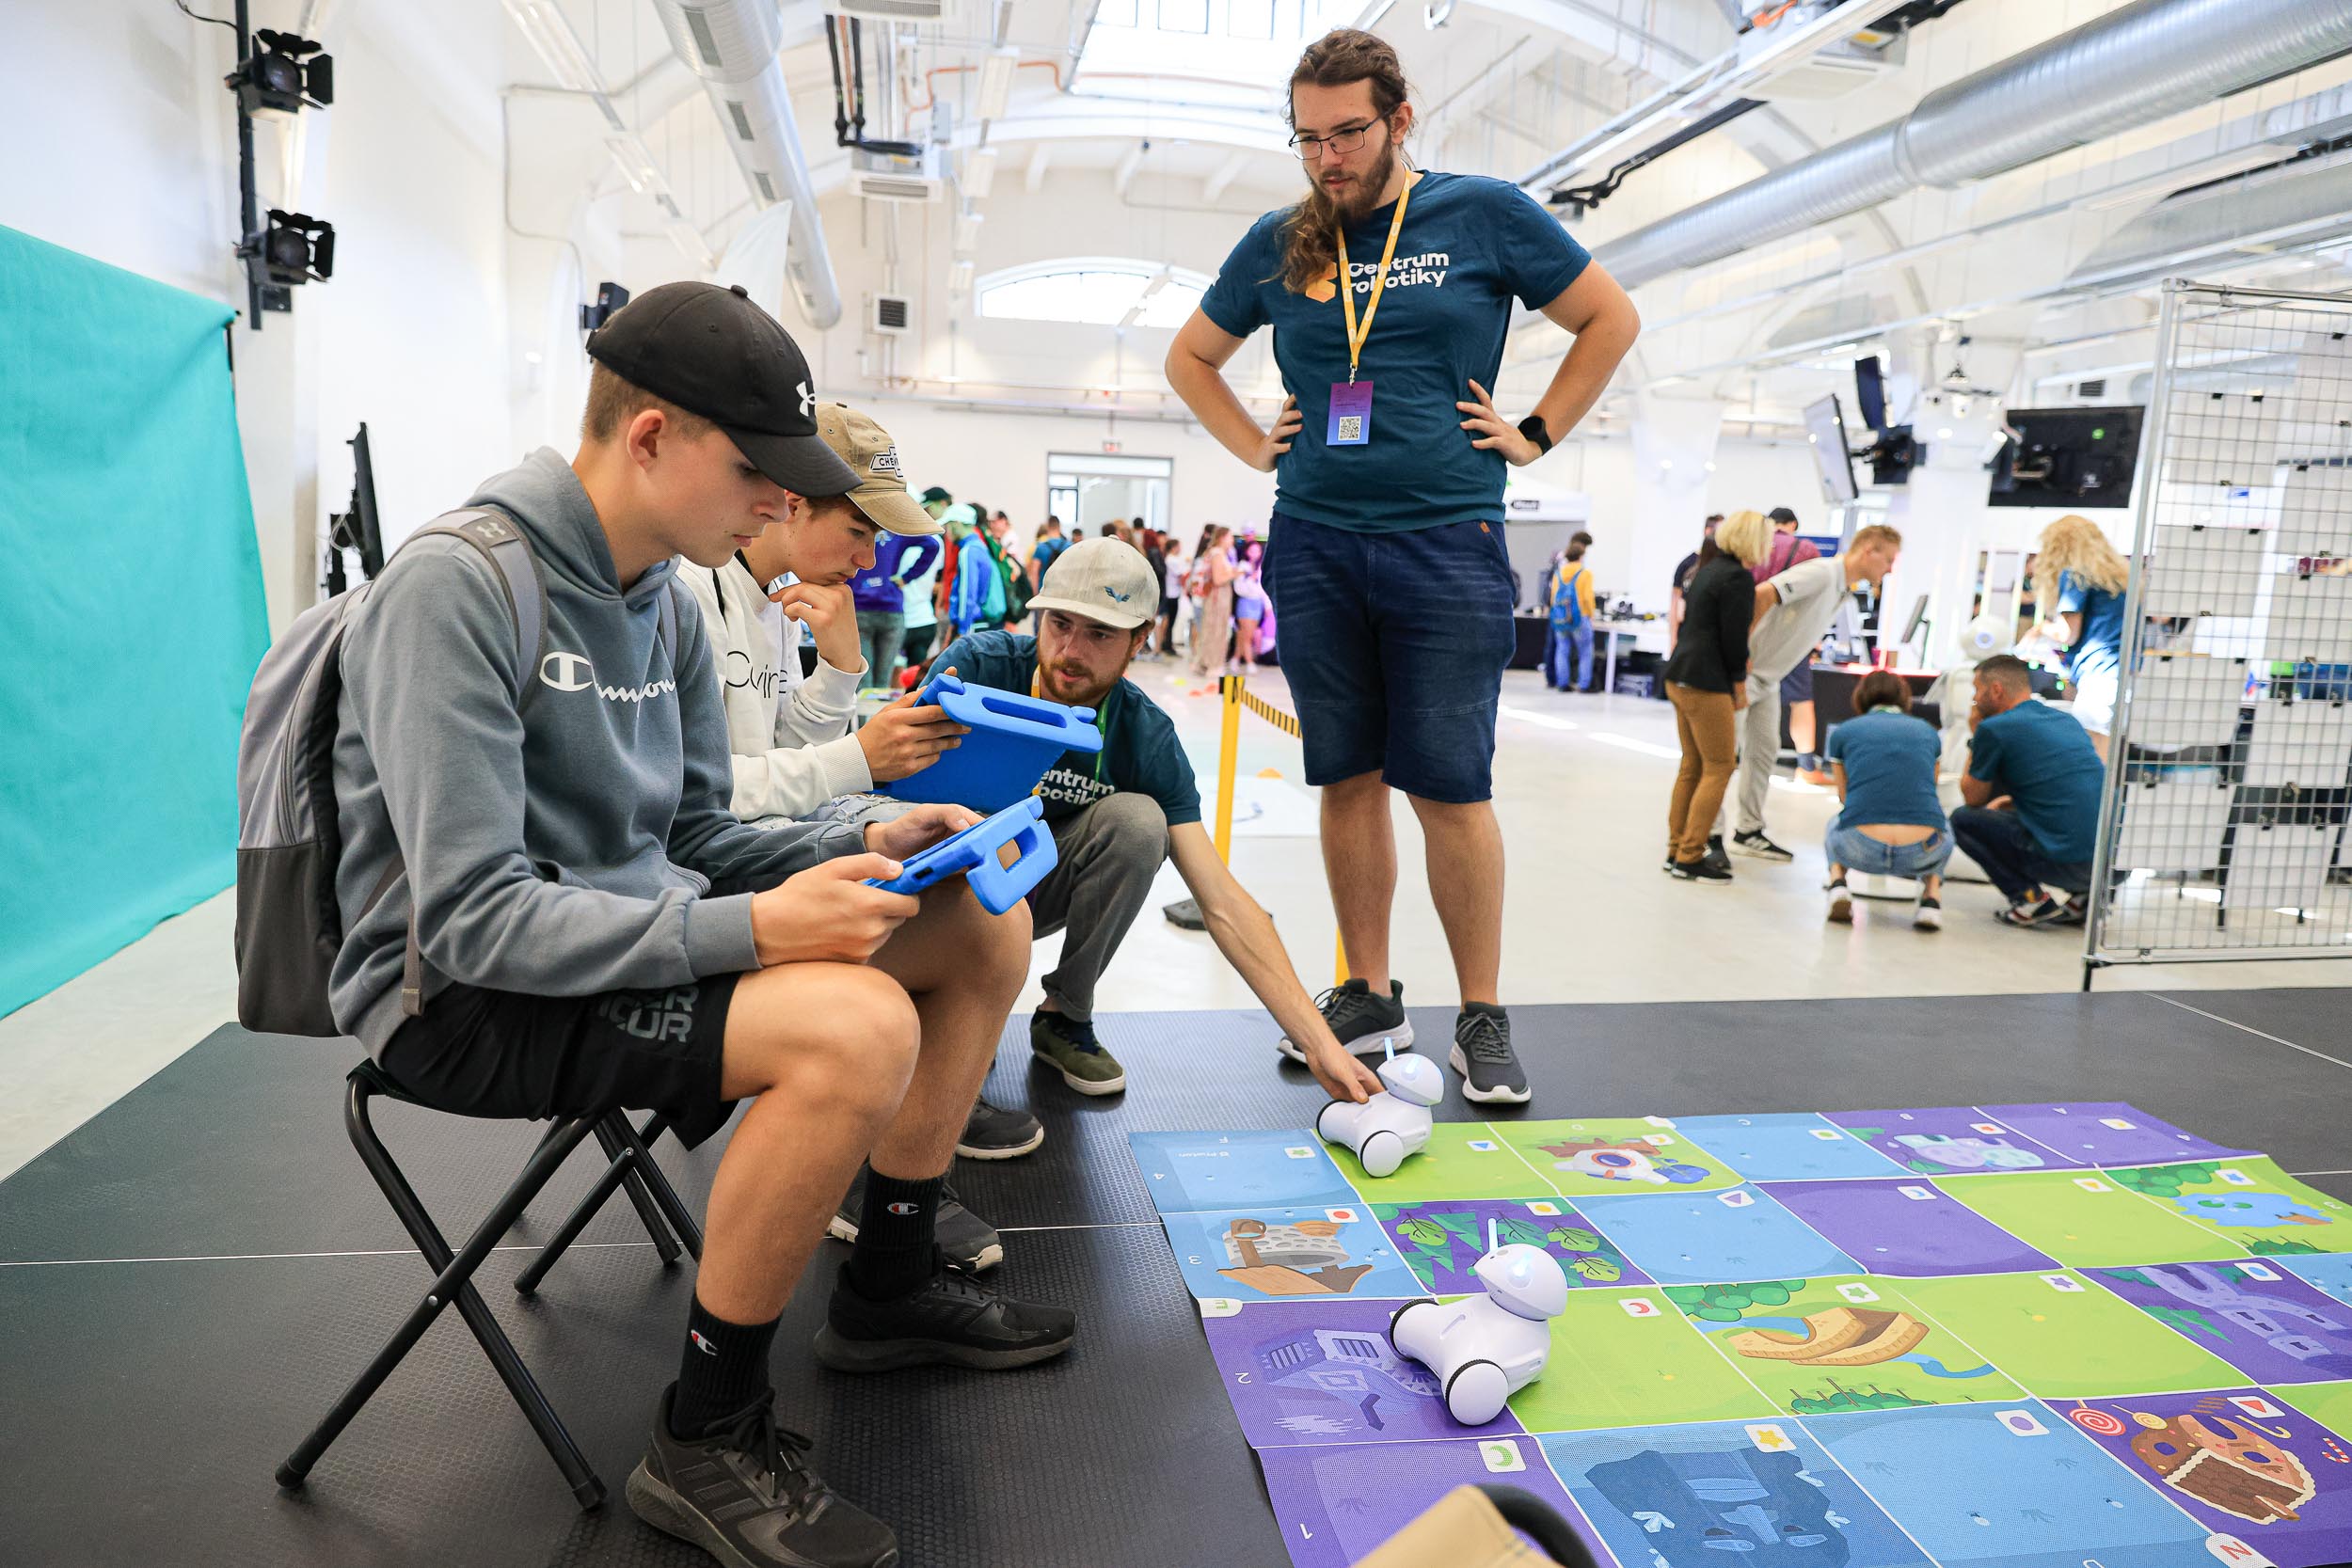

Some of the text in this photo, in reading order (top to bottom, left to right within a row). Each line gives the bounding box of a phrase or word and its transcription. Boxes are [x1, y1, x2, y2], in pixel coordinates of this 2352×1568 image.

[1041, 768, 1115, 795] entrum
[1188, 1255, 1202, 1265] 3
[1235, 1371, 1252, 1385] 2
[1299, 1523, 1313, 1540] 1
